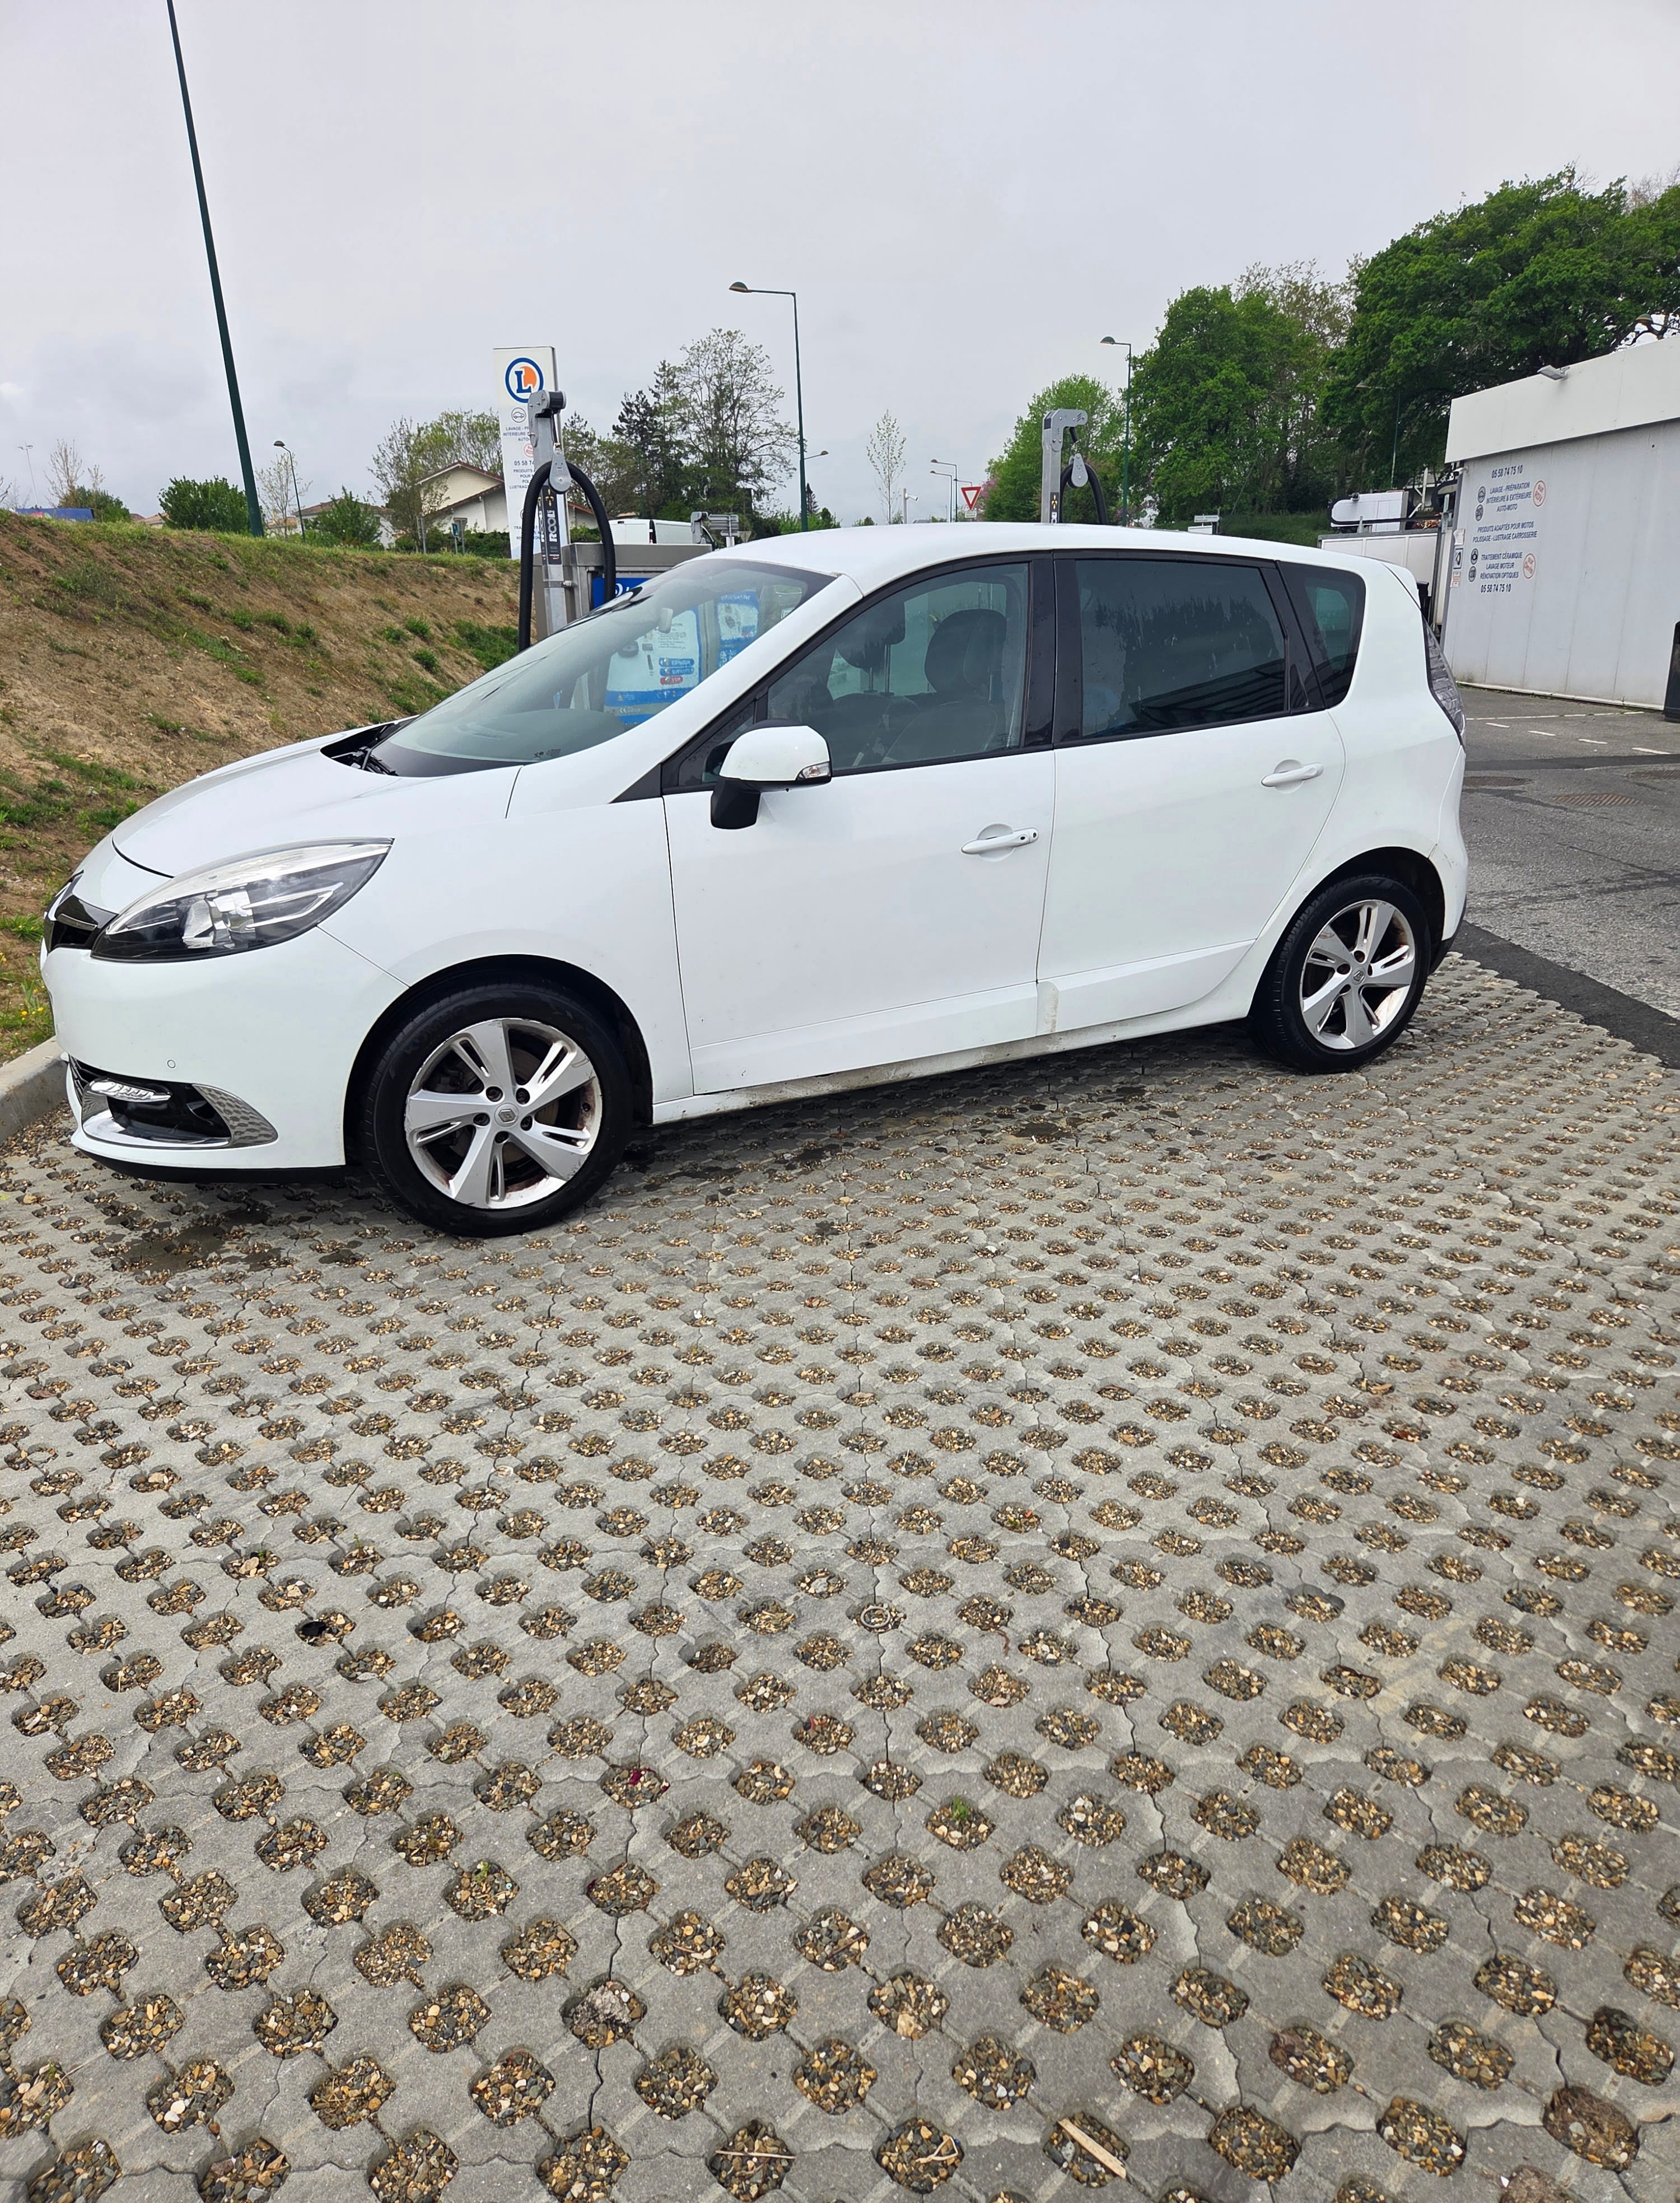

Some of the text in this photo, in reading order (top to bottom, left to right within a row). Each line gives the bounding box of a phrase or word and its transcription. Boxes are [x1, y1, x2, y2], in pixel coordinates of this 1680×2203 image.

[515, 371, 531, 393] L
[1492, 465, 1523, 478] 05 58 74 75 10
[1490, 486, 1503, 494] LAVAGE
[1505, 482, 1530, 492] PRÉPARATION
[1486, 495, 1506, 504] INTÉRIEURE
[1510, 491, 1532, 501] EXTÉRIEURE
[1496, 503, 1518, 512] AUTO-MOTO
[1494, 522, 1510, 531] ADAPTÉS
[1512, 531, 1537, 539] CARROSSERIE
[1481, 584, 1486, 592] 05
[1487, 584, 1492, 592] 58
[1499, 584, 1505, 592] 75
[1506, 584, 1511, 592] 10
